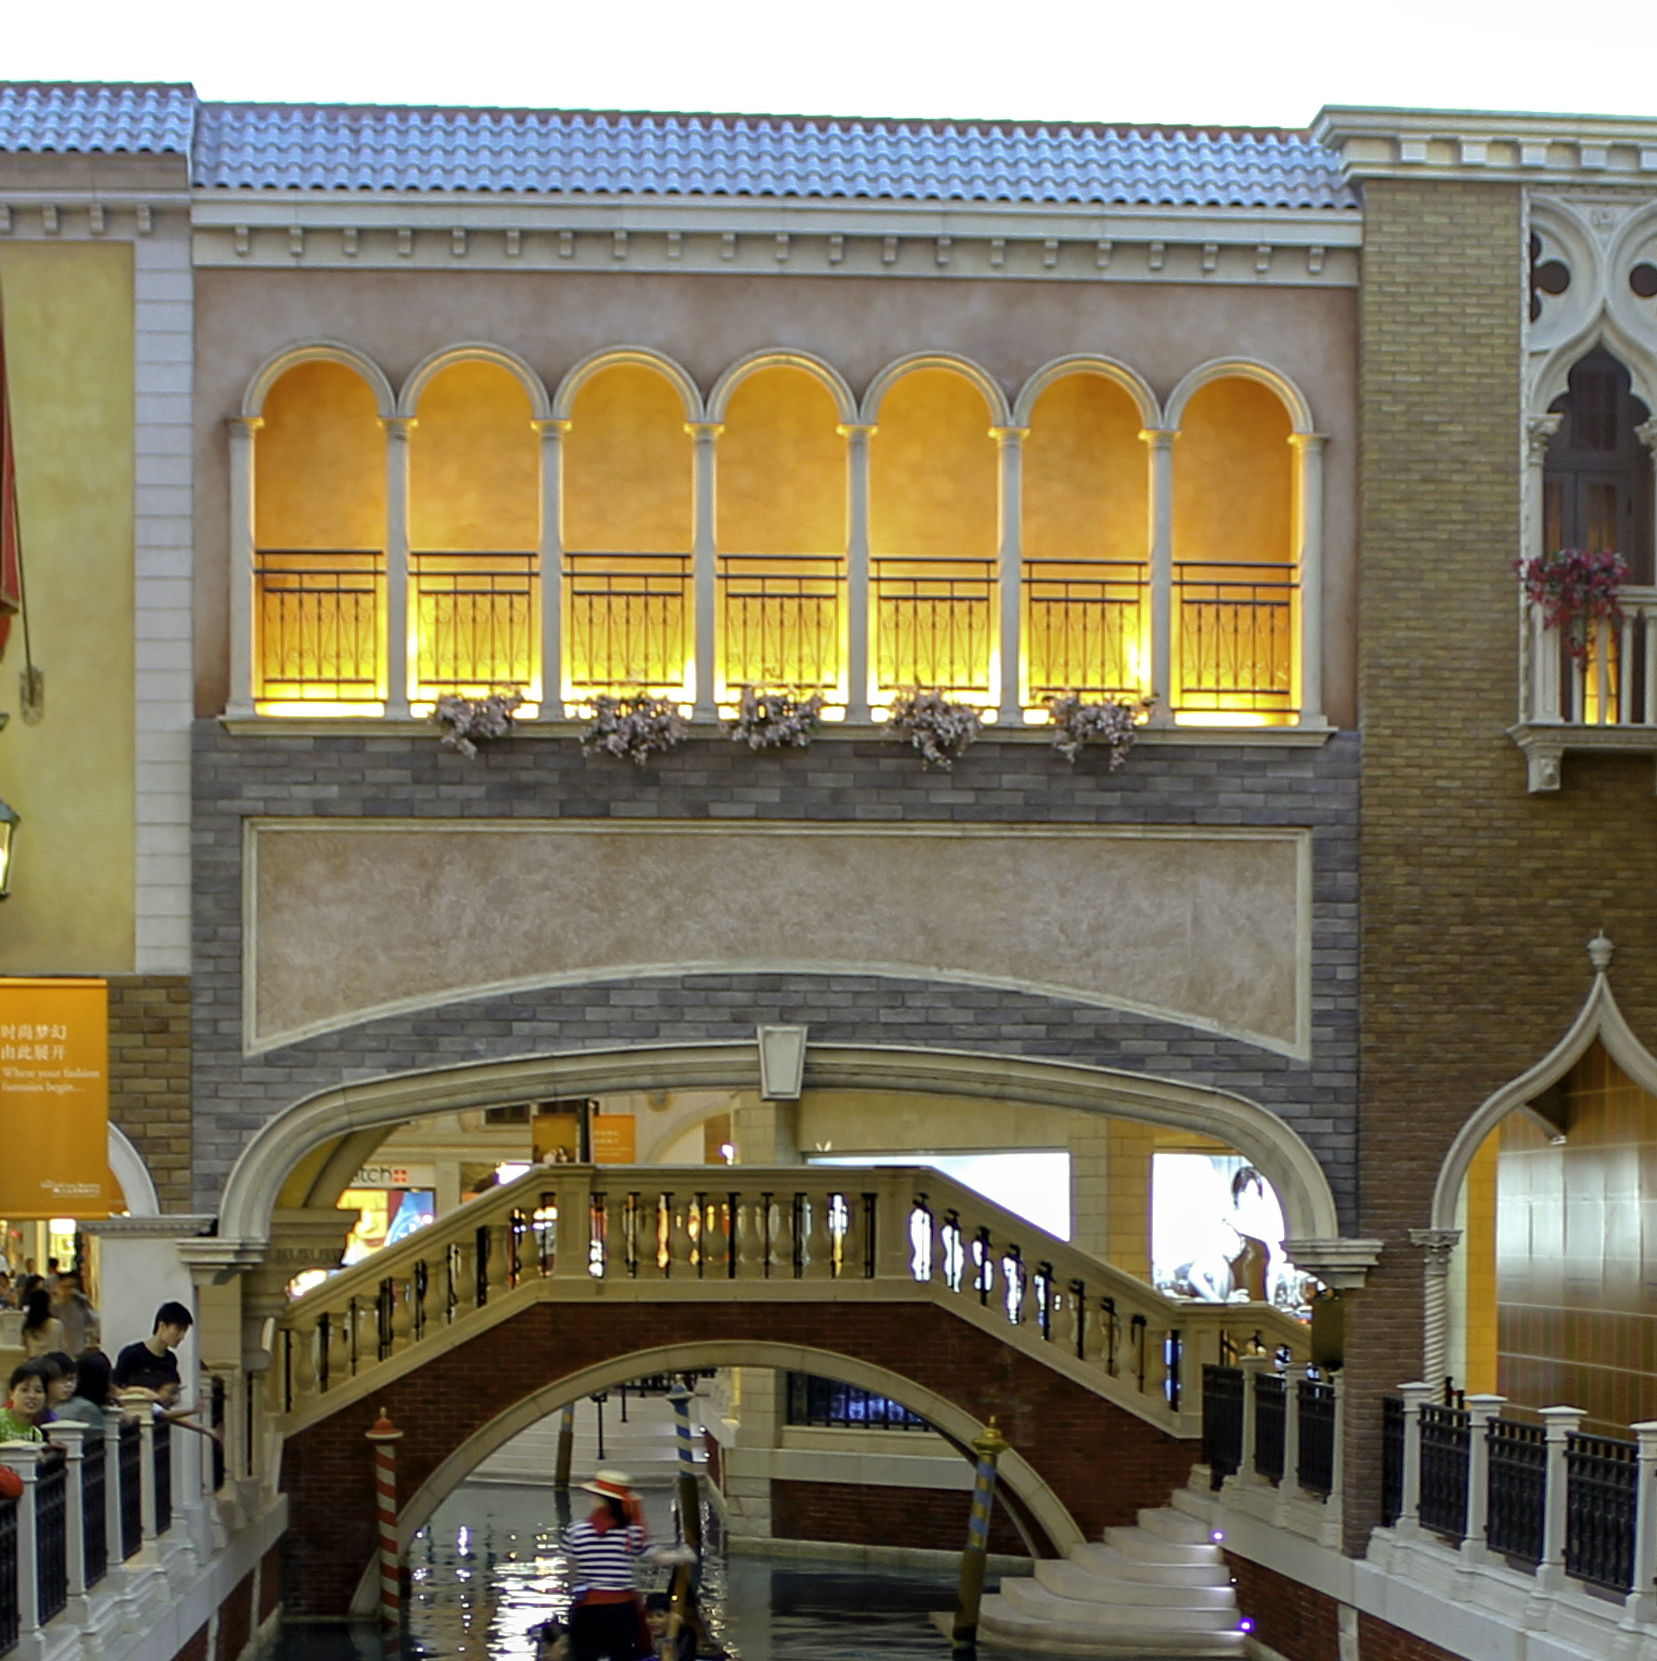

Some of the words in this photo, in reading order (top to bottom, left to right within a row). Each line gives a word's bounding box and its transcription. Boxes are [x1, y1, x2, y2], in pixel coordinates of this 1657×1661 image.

[2, 1066, 36, 1078] Where
[37, 1070, 61, 1080] your
[63, 1066, 100, 1078] fashion
